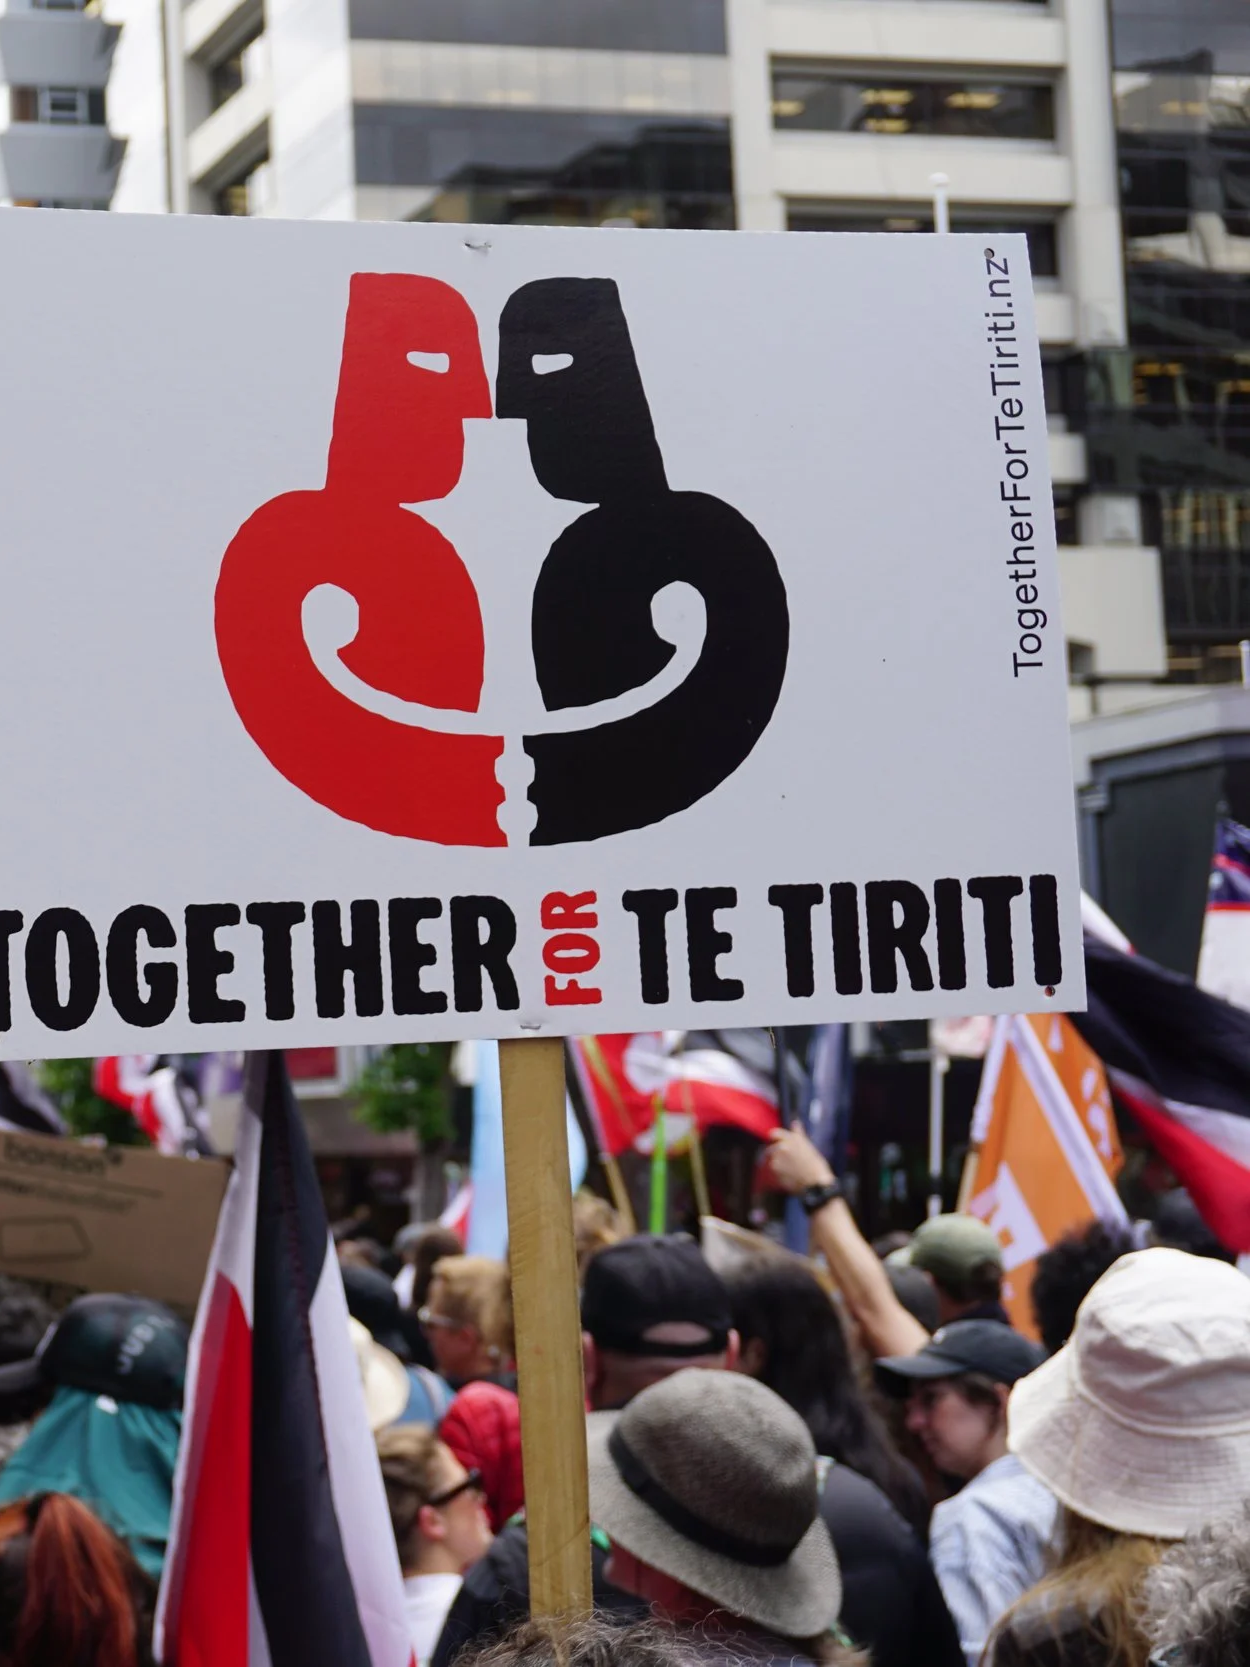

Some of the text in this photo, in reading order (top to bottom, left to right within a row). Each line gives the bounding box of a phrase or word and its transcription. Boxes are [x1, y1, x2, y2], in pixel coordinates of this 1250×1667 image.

[984, 256, 1047, 678] TogetherForTeTiriti.nz
[539, 890, 603, 1007] FOR
[621, 886, 745, 1005] TE
[766, 873, 1064, 999] TIRITI
